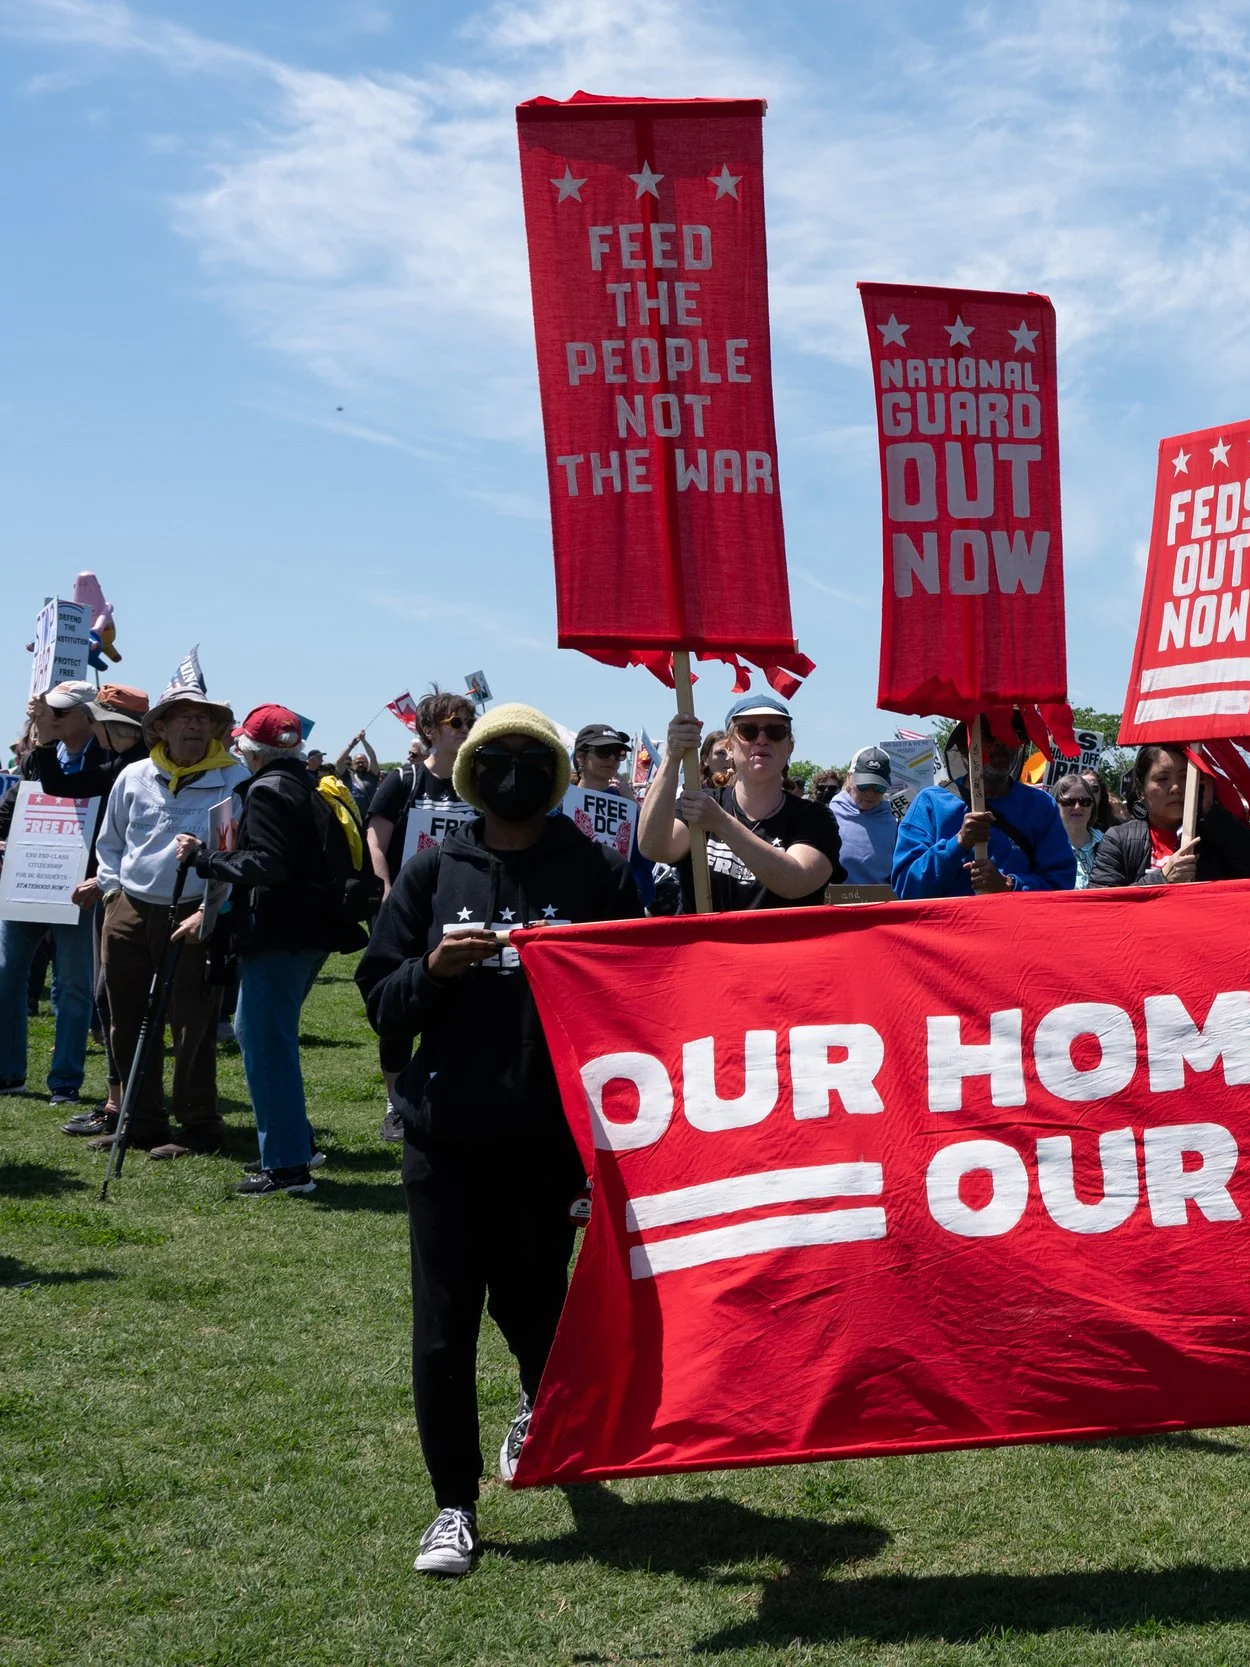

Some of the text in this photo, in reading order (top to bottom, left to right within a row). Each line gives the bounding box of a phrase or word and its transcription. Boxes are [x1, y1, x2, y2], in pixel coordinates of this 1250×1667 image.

[588, 223, 712, 271] FEED
[606, 281, 702, 328] THE
[565, 337, 752, 386] PEOPLE
[880, 357, 1040, 393] NATIONAL
[615, 393, 711, 439] NOT
[882, 391, 1042, 439] GUARD
[557, 449, 774, 497] THE WAR
[886, 441, 1042, 522] OUT
[892, 529, 1050, 598] NOW
[58, 612, 82, 624] DEFEND
[64, 623, 76, 632] THE
[1158, 589, 1250, 653] NOW
[54, 656, 82, 667] PROTECT
[58, 668, 75, 677] FREE
[25, 820, 84, 836] FREE DC
[584, 794, 628, 821] FREE
[594, 814, 618, 836] DC
[15, 882, 51, 890] STATEHOOD
[28, 862, 64, 870] CITIZENSHIP
[841, 888, 860, 900] and
[579, 1022, 885, 1151] OUR
[926, 1122, 1242, 1237] OUR
